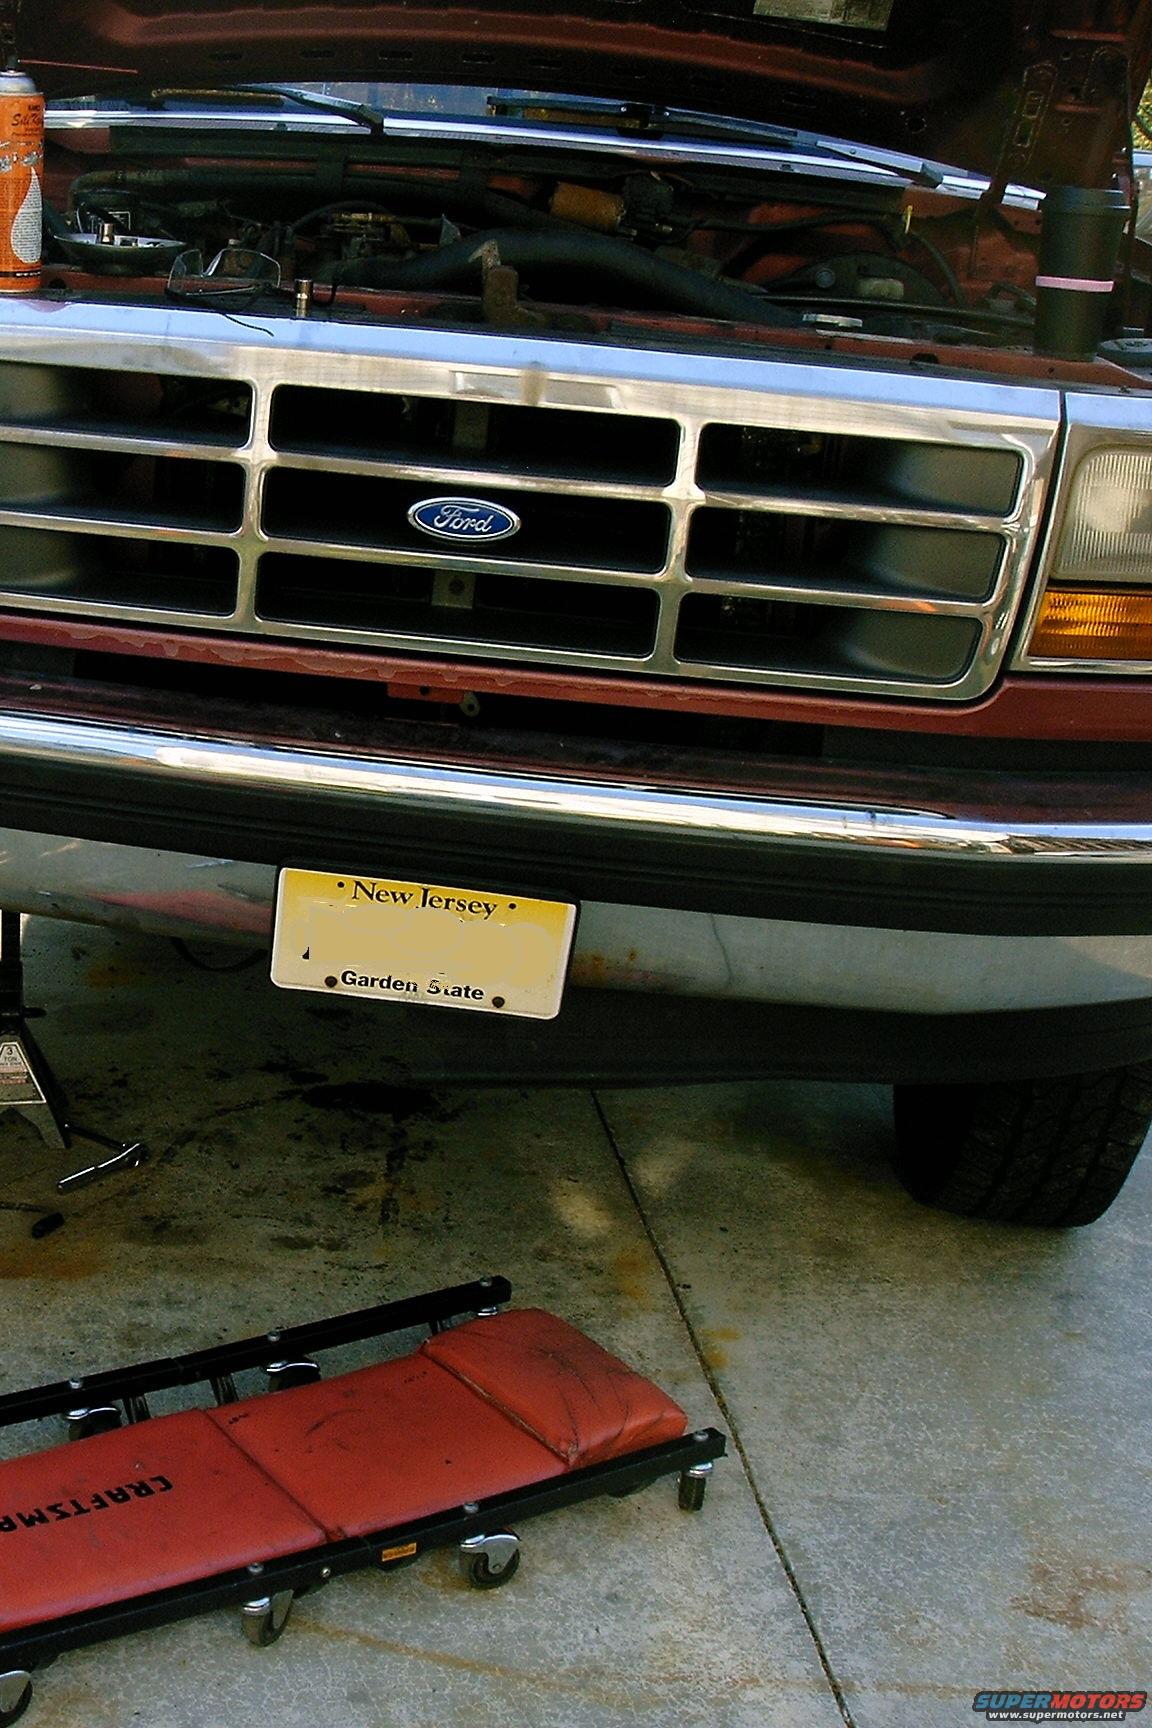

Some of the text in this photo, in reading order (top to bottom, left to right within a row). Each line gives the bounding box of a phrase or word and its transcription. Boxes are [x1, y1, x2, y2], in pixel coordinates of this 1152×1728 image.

[434, 505, 492, 532] Ford
[351, 880, 497, 920] New Jersey
[340, 970, 418, 992] Garden
